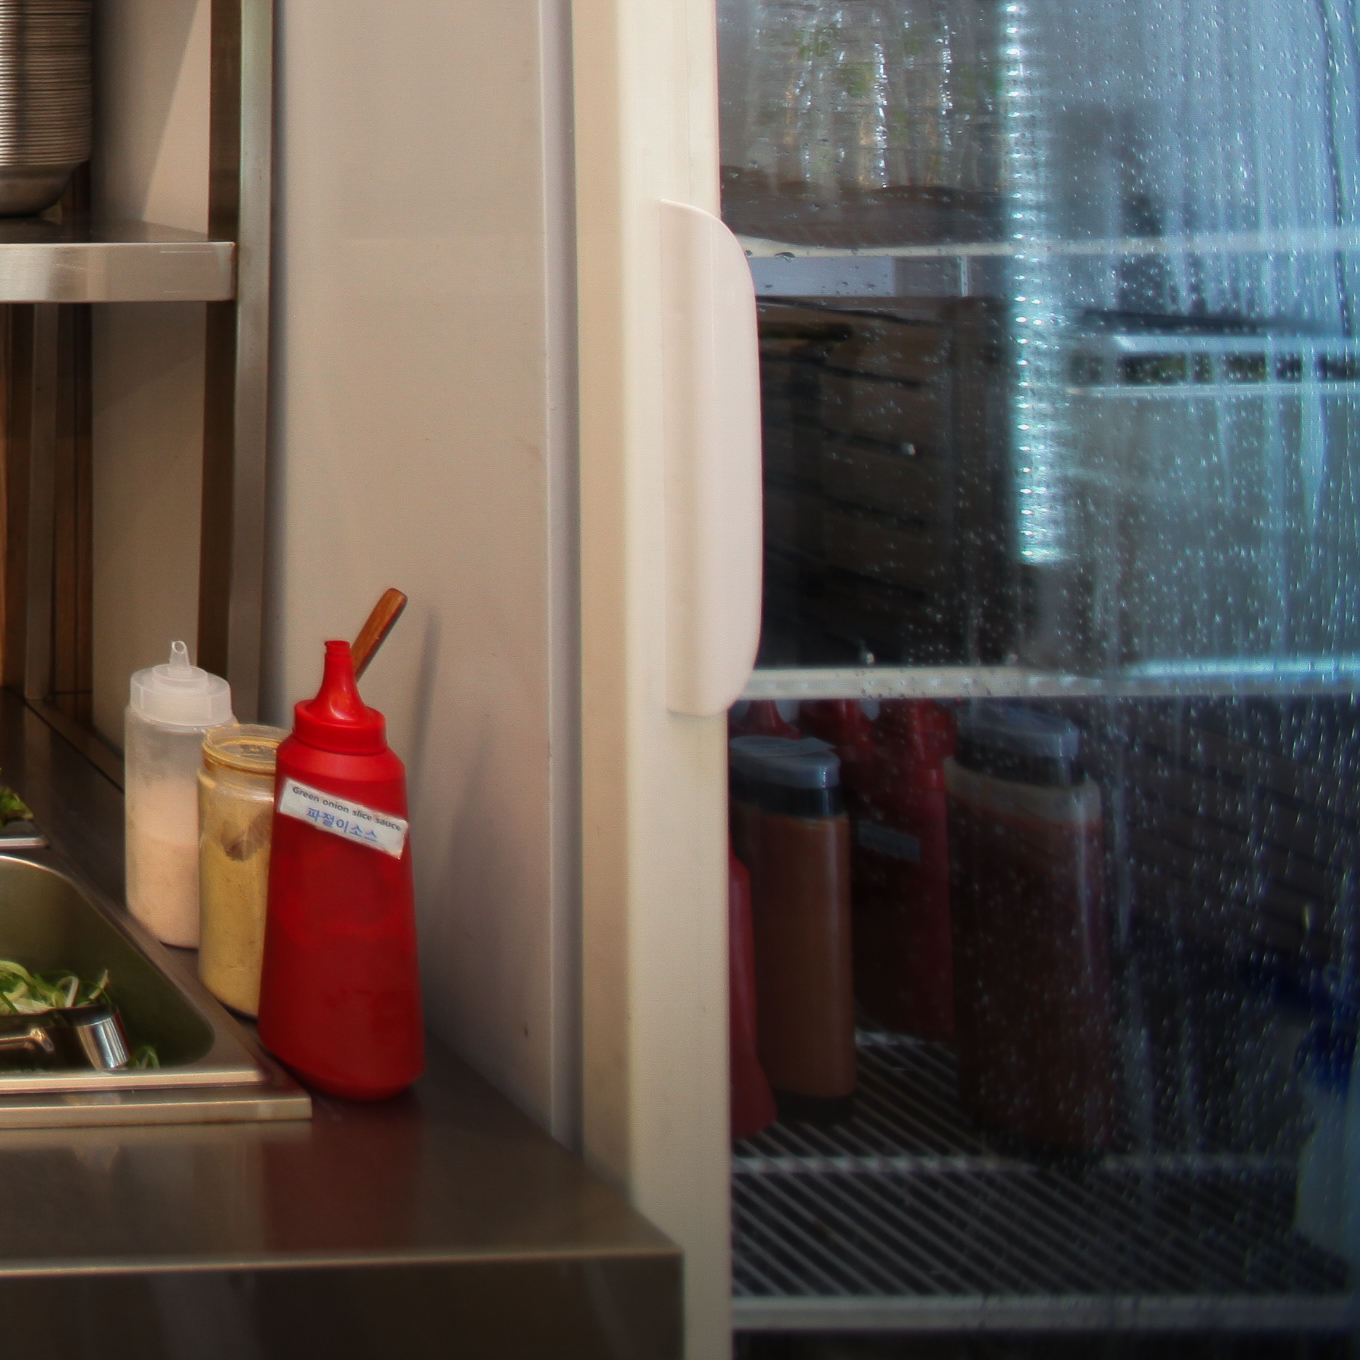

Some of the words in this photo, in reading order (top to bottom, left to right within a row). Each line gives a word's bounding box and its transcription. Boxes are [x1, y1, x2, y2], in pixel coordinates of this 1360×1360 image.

[292, 786, 320, 803] Green
[322, 797, 350, 813] onion
[352, 808, 373, 822] slice
[375, 817, 402, 832] sauce
[306, 807, 378, 842] 파절이소스
